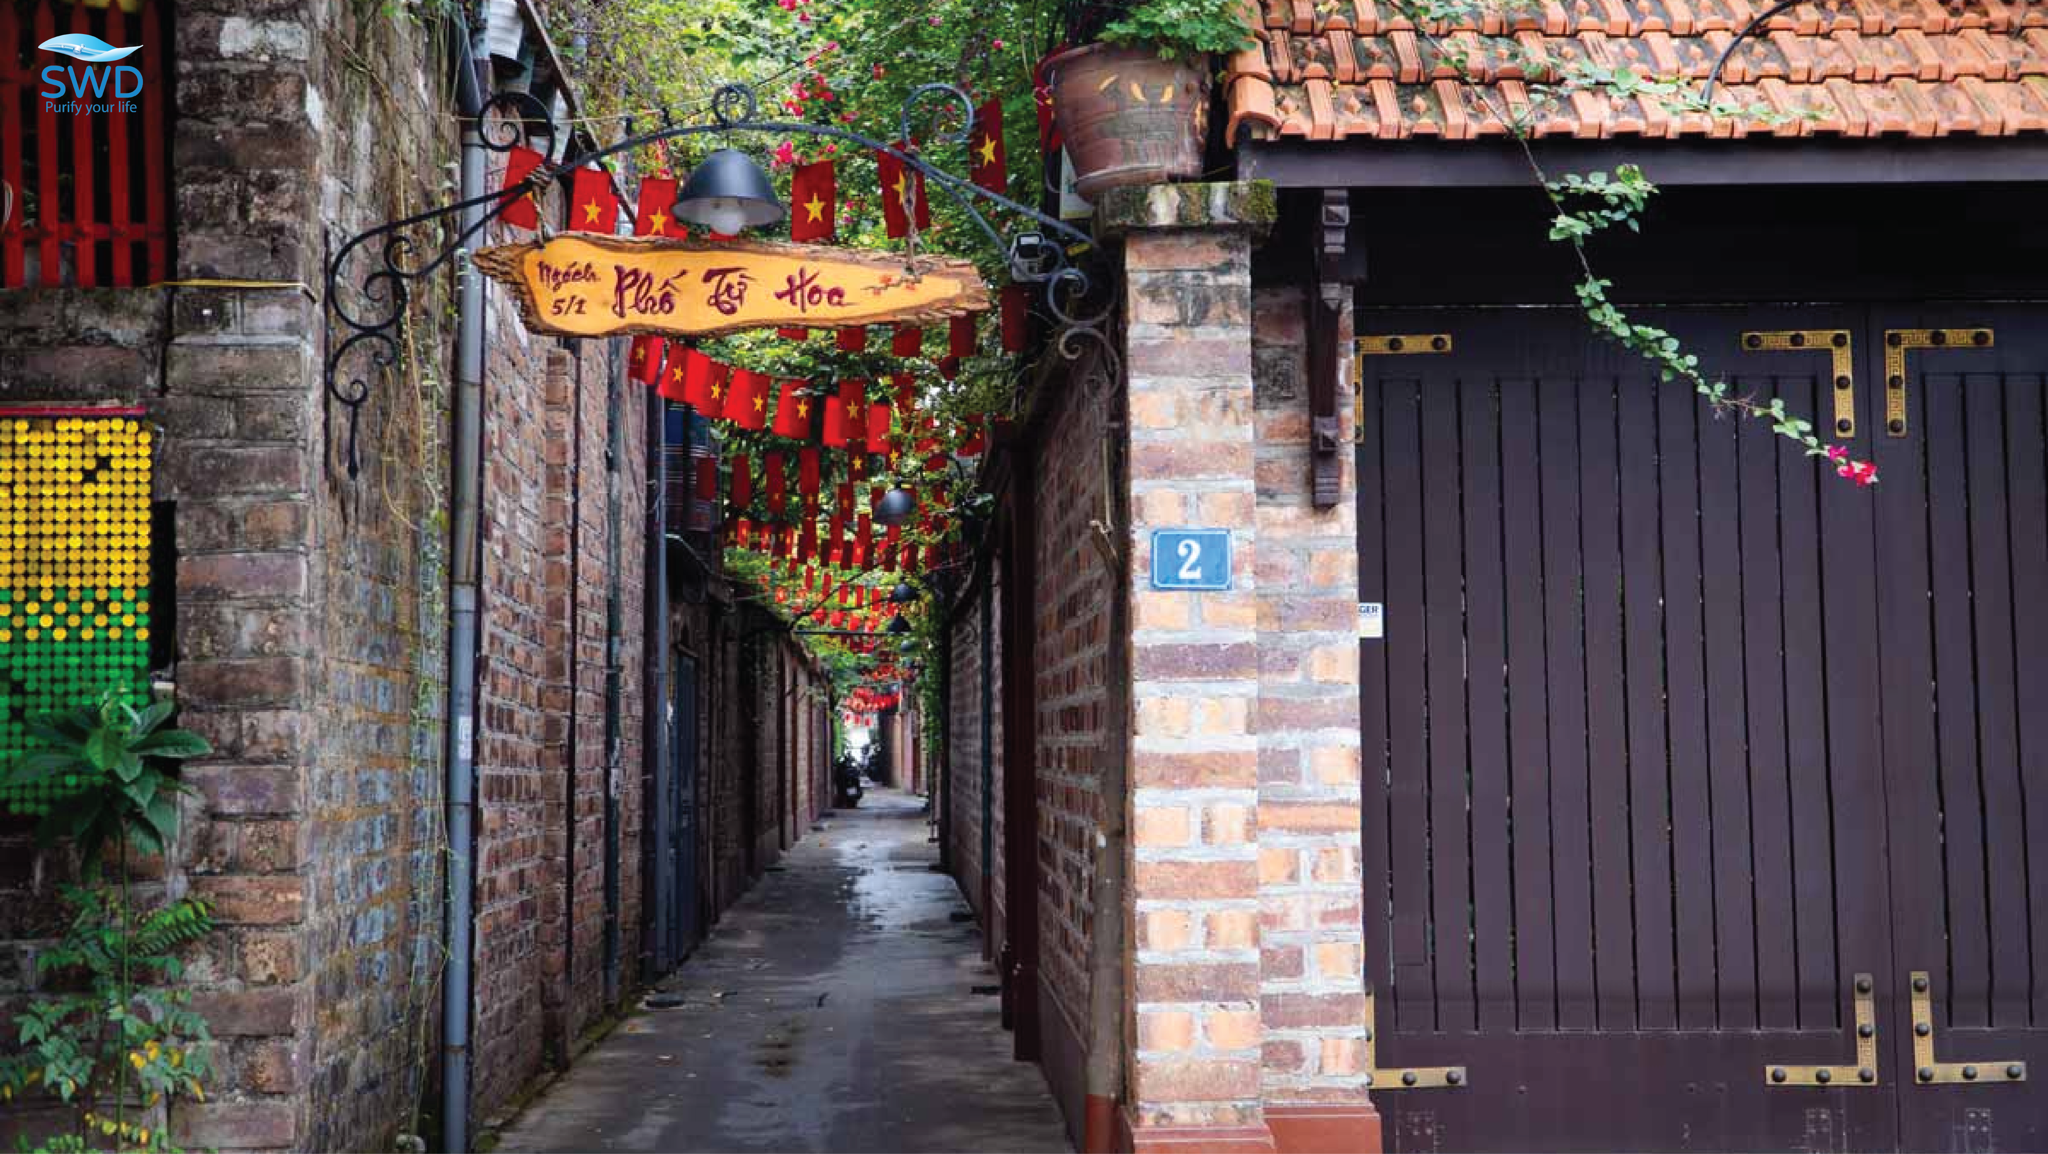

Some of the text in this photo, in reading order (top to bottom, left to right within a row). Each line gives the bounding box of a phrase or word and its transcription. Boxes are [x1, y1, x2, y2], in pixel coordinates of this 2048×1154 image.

[551, 295, 587, 316] 5/1
[611, 264, 688, 318] Phố
[774, 266, 850, 314] Hoa
[1177, 538, 1202, 580] 2
